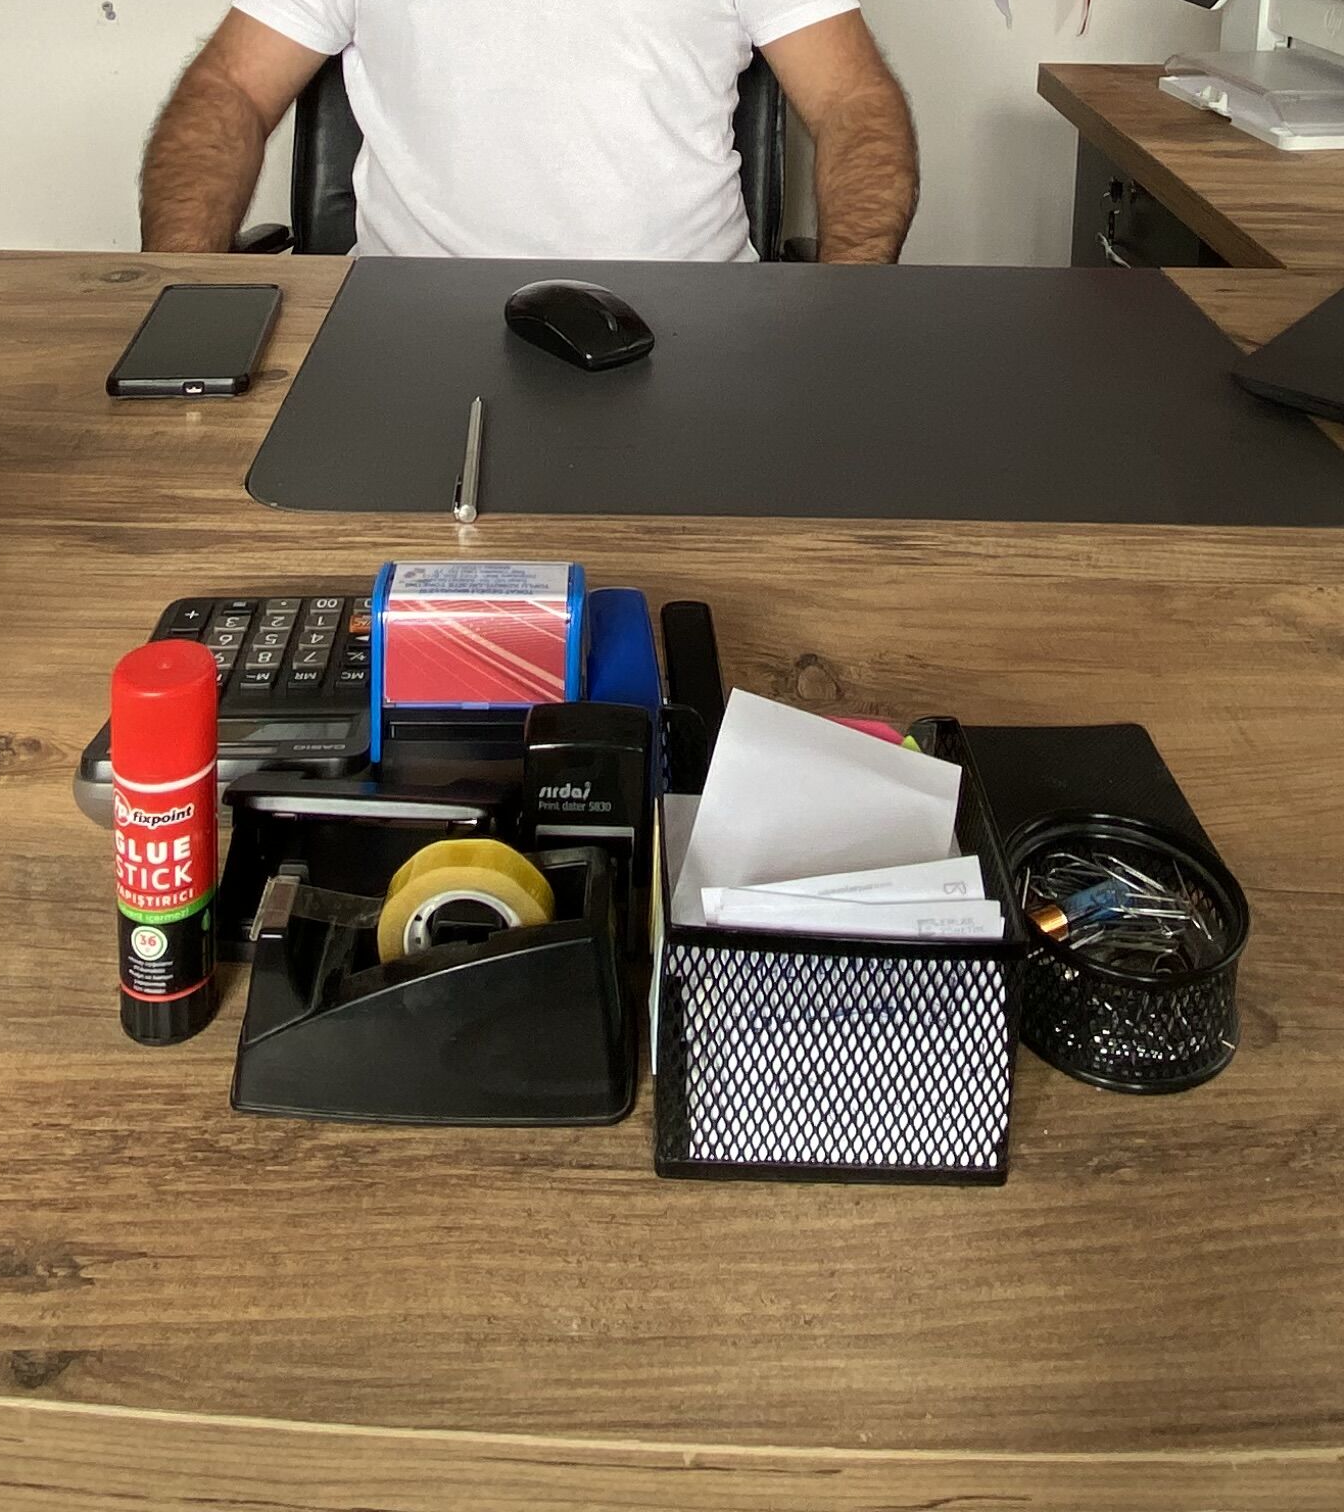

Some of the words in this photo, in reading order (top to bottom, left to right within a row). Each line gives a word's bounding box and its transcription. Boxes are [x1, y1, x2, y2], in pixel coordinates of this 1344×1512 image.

[316, 599, 338, 608] 00
[224, 616, 239, 627] 3
[271, 616, 286, 626] 2
[317, 617, 325, 626] 1
[219, 635, 233, 645] 6
[264, 634, 279, 645] 5
[310, 635, 324, 644] 4
[257, 652, 272, 663] 8
[304, 652, 317, 662] 7
[294, 672, 317, 680] MR
[341, 672, 364, 680] MC
[293, 743, 346, 751] CASIO
[133, 806, 192, 826] fixpoint
[116, 830, 191, 864] GLUE
[116, 854, 193, 890] STICK
[139, 934, 157, 946] 36
